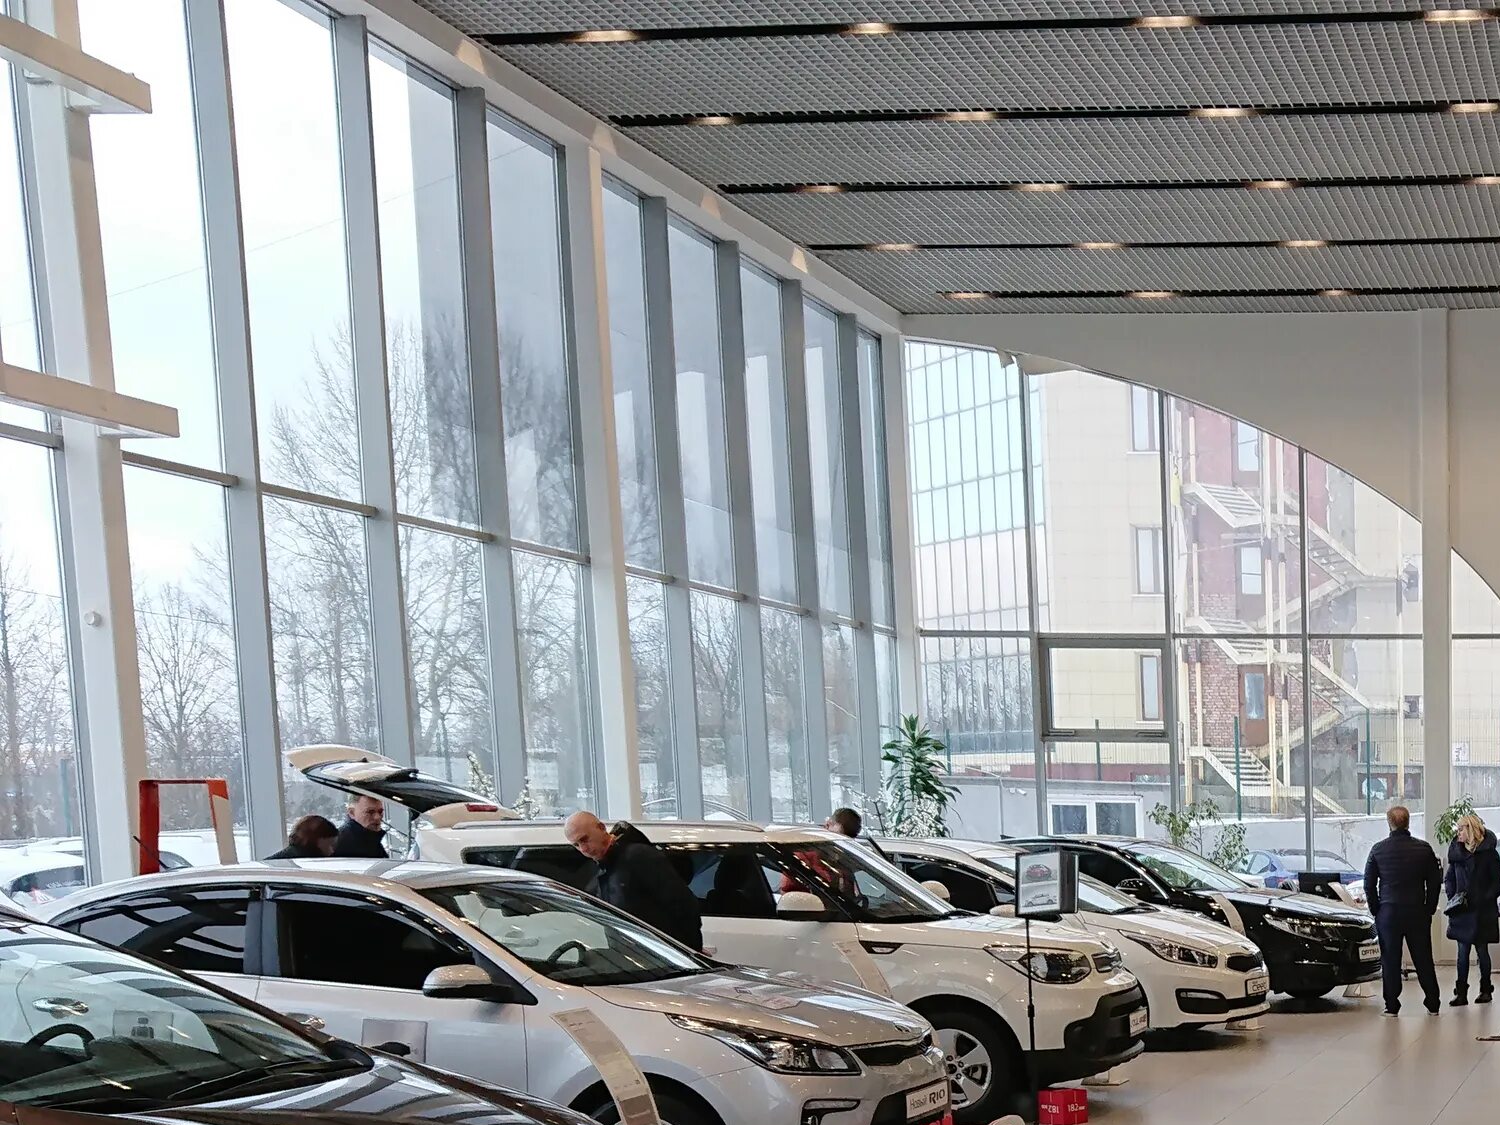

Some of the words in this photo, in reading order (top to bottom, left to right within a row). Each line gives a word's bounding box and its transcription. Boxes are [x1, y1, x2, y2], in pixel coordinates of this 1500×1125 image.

[909, 1094, 928, 1109] Новый
[928, 1088, 946, 1104] RIO
[1067, 1103, 1079, 1112] 182
